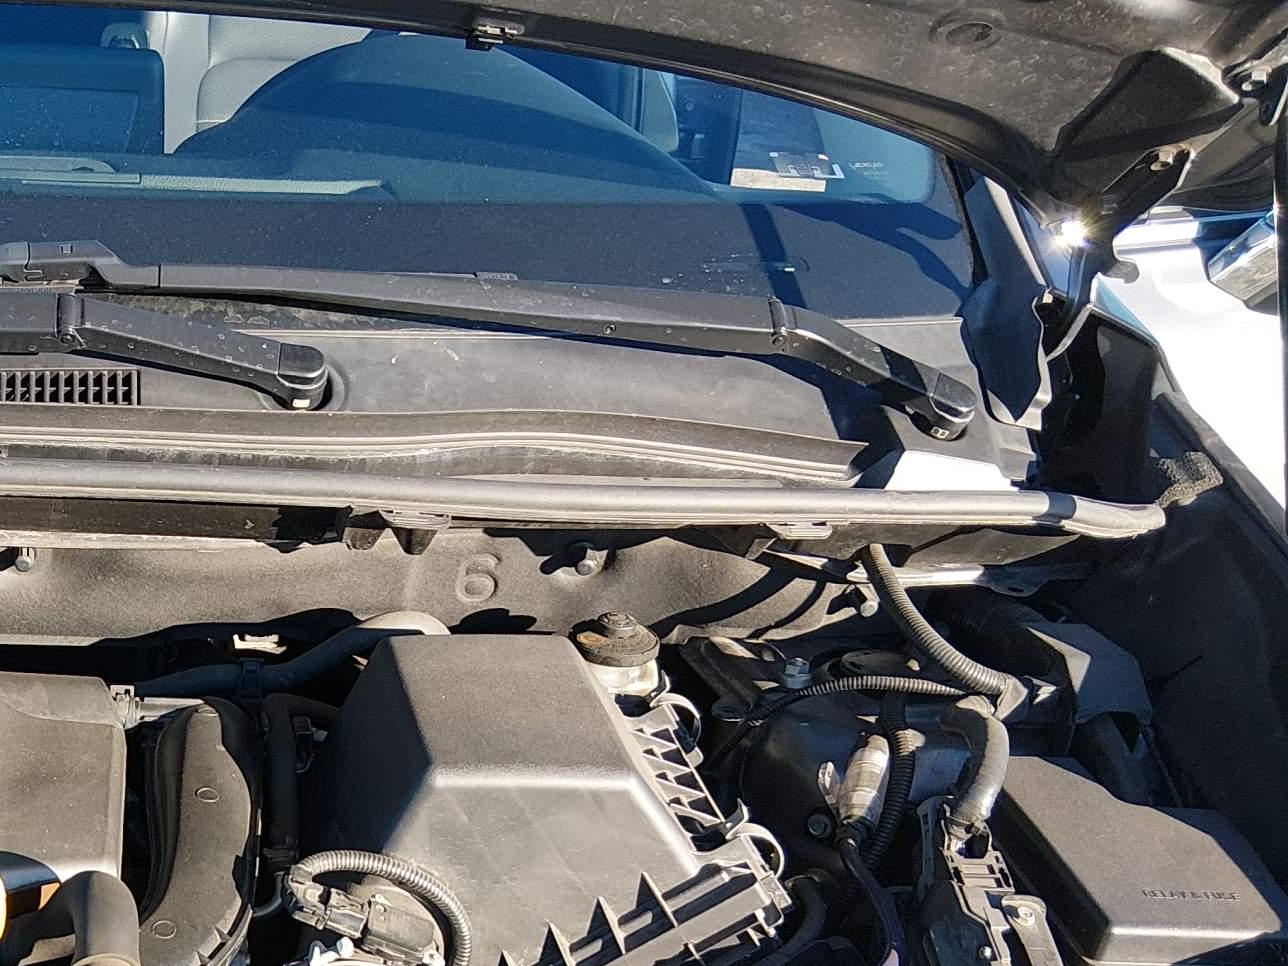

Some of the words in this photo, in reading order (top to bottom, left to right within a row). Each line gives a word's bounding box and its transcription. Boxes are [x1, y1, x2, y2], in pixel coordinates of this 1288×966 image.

[457, 553, 500, 603] 6
[1141, 889, 1187, 899] RELAY
[1191, 891, 1202, 899] &
[1204, 891, 1241, 901] FUSE
